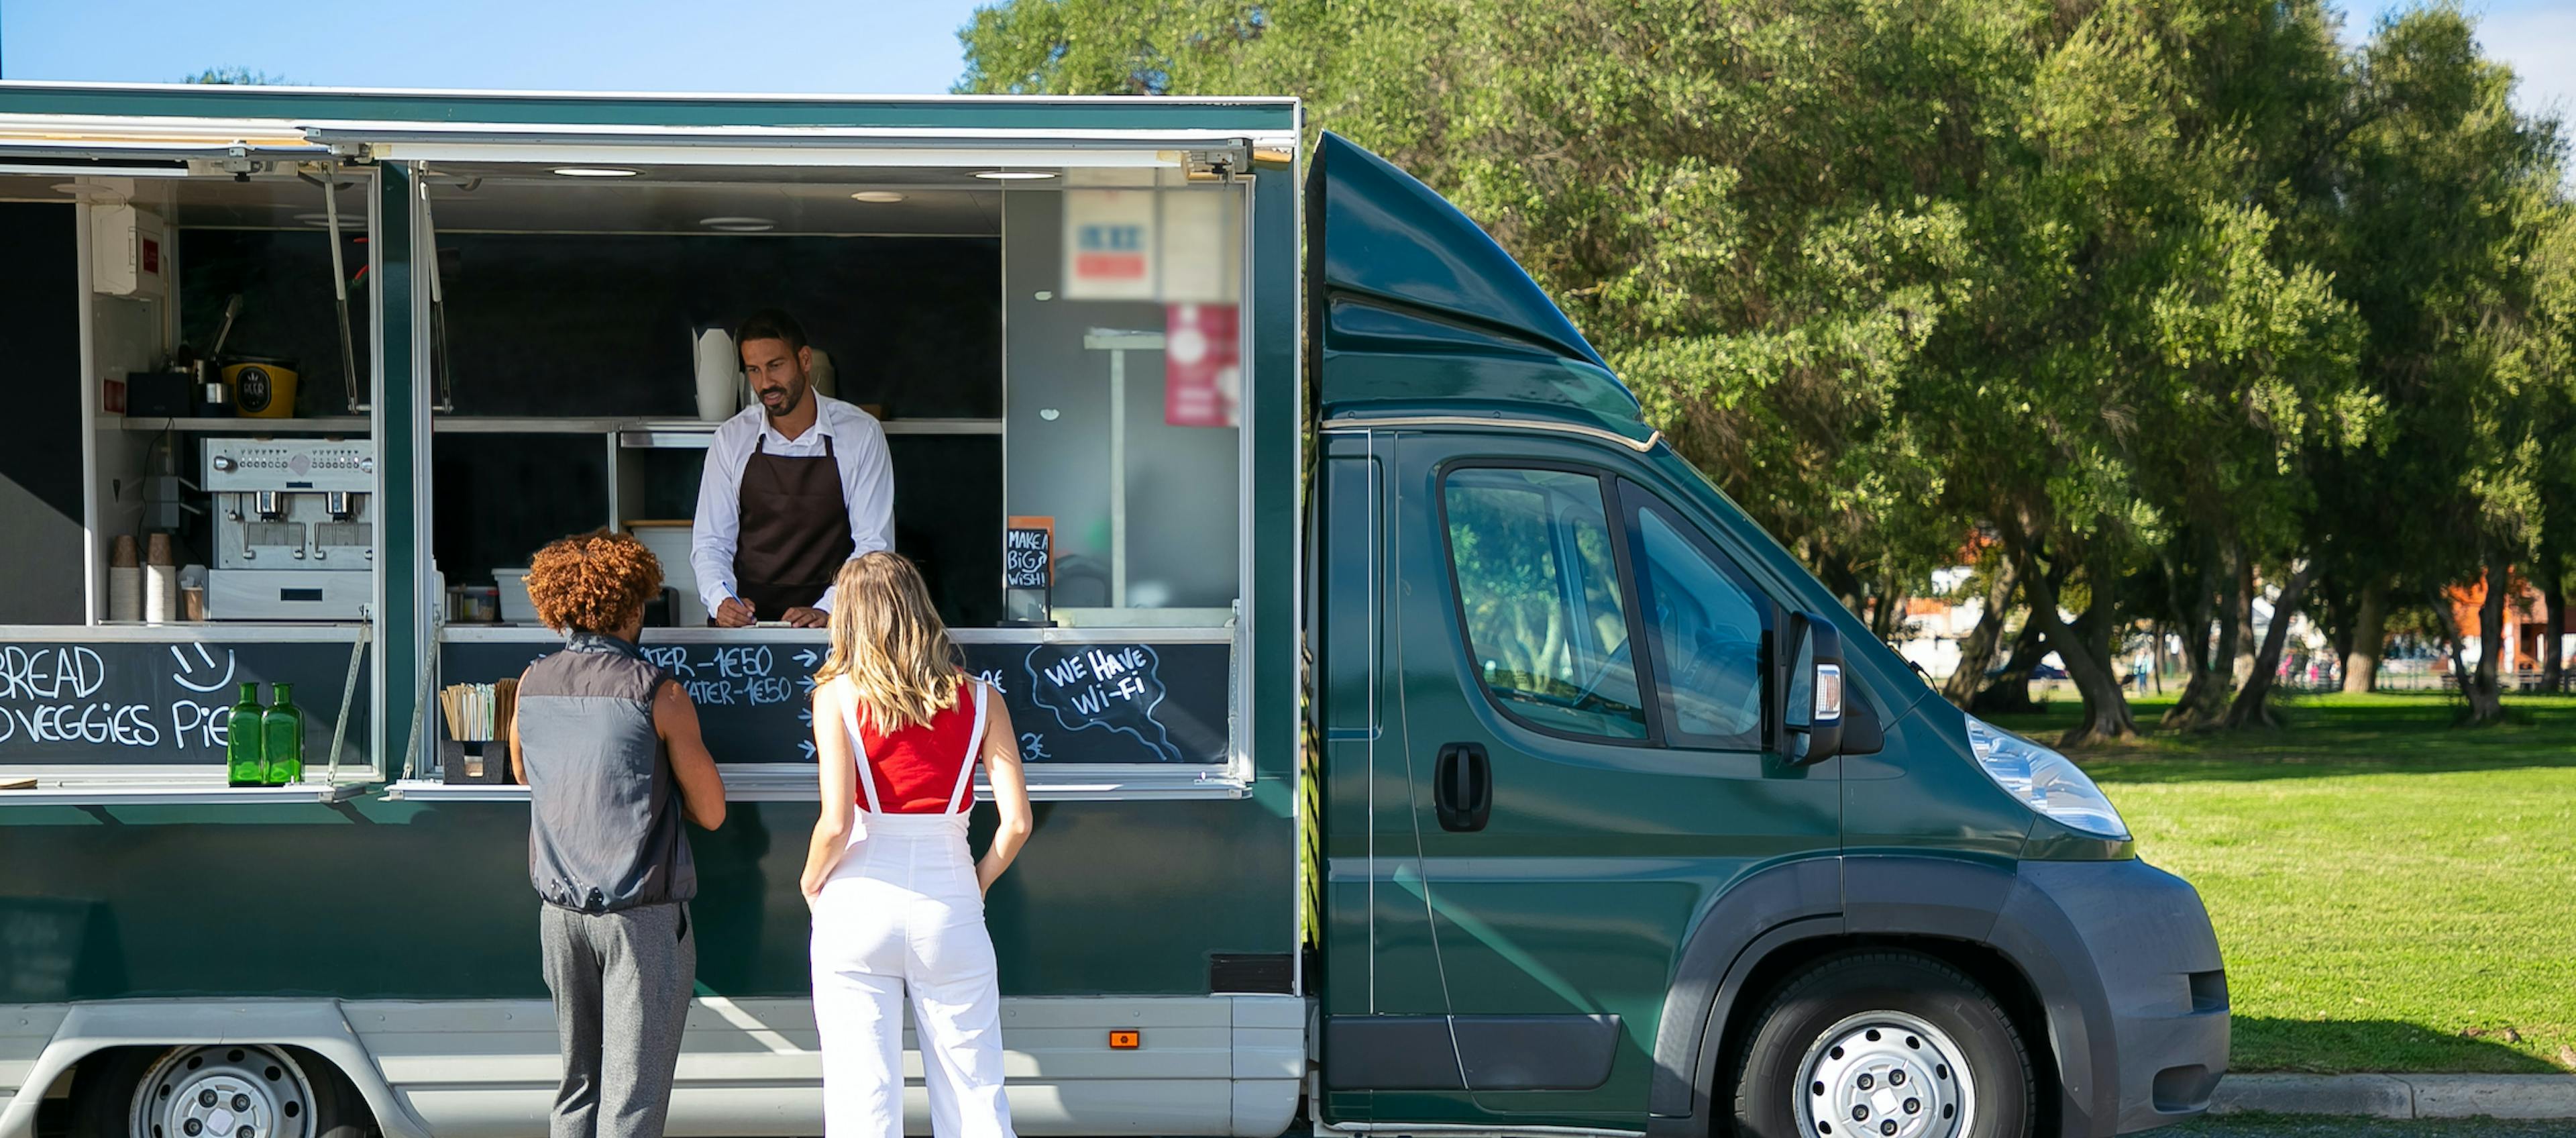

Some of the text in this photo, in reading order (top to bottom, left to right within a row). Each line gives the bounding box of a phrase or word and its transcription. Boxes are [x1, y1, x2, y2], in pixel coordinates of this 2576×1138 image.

[1008, 531, 1049, 550] MAKE A
[1044, 647, 1147, 688] WE HAVE
[1020, 732, 1052, 761] 3€
